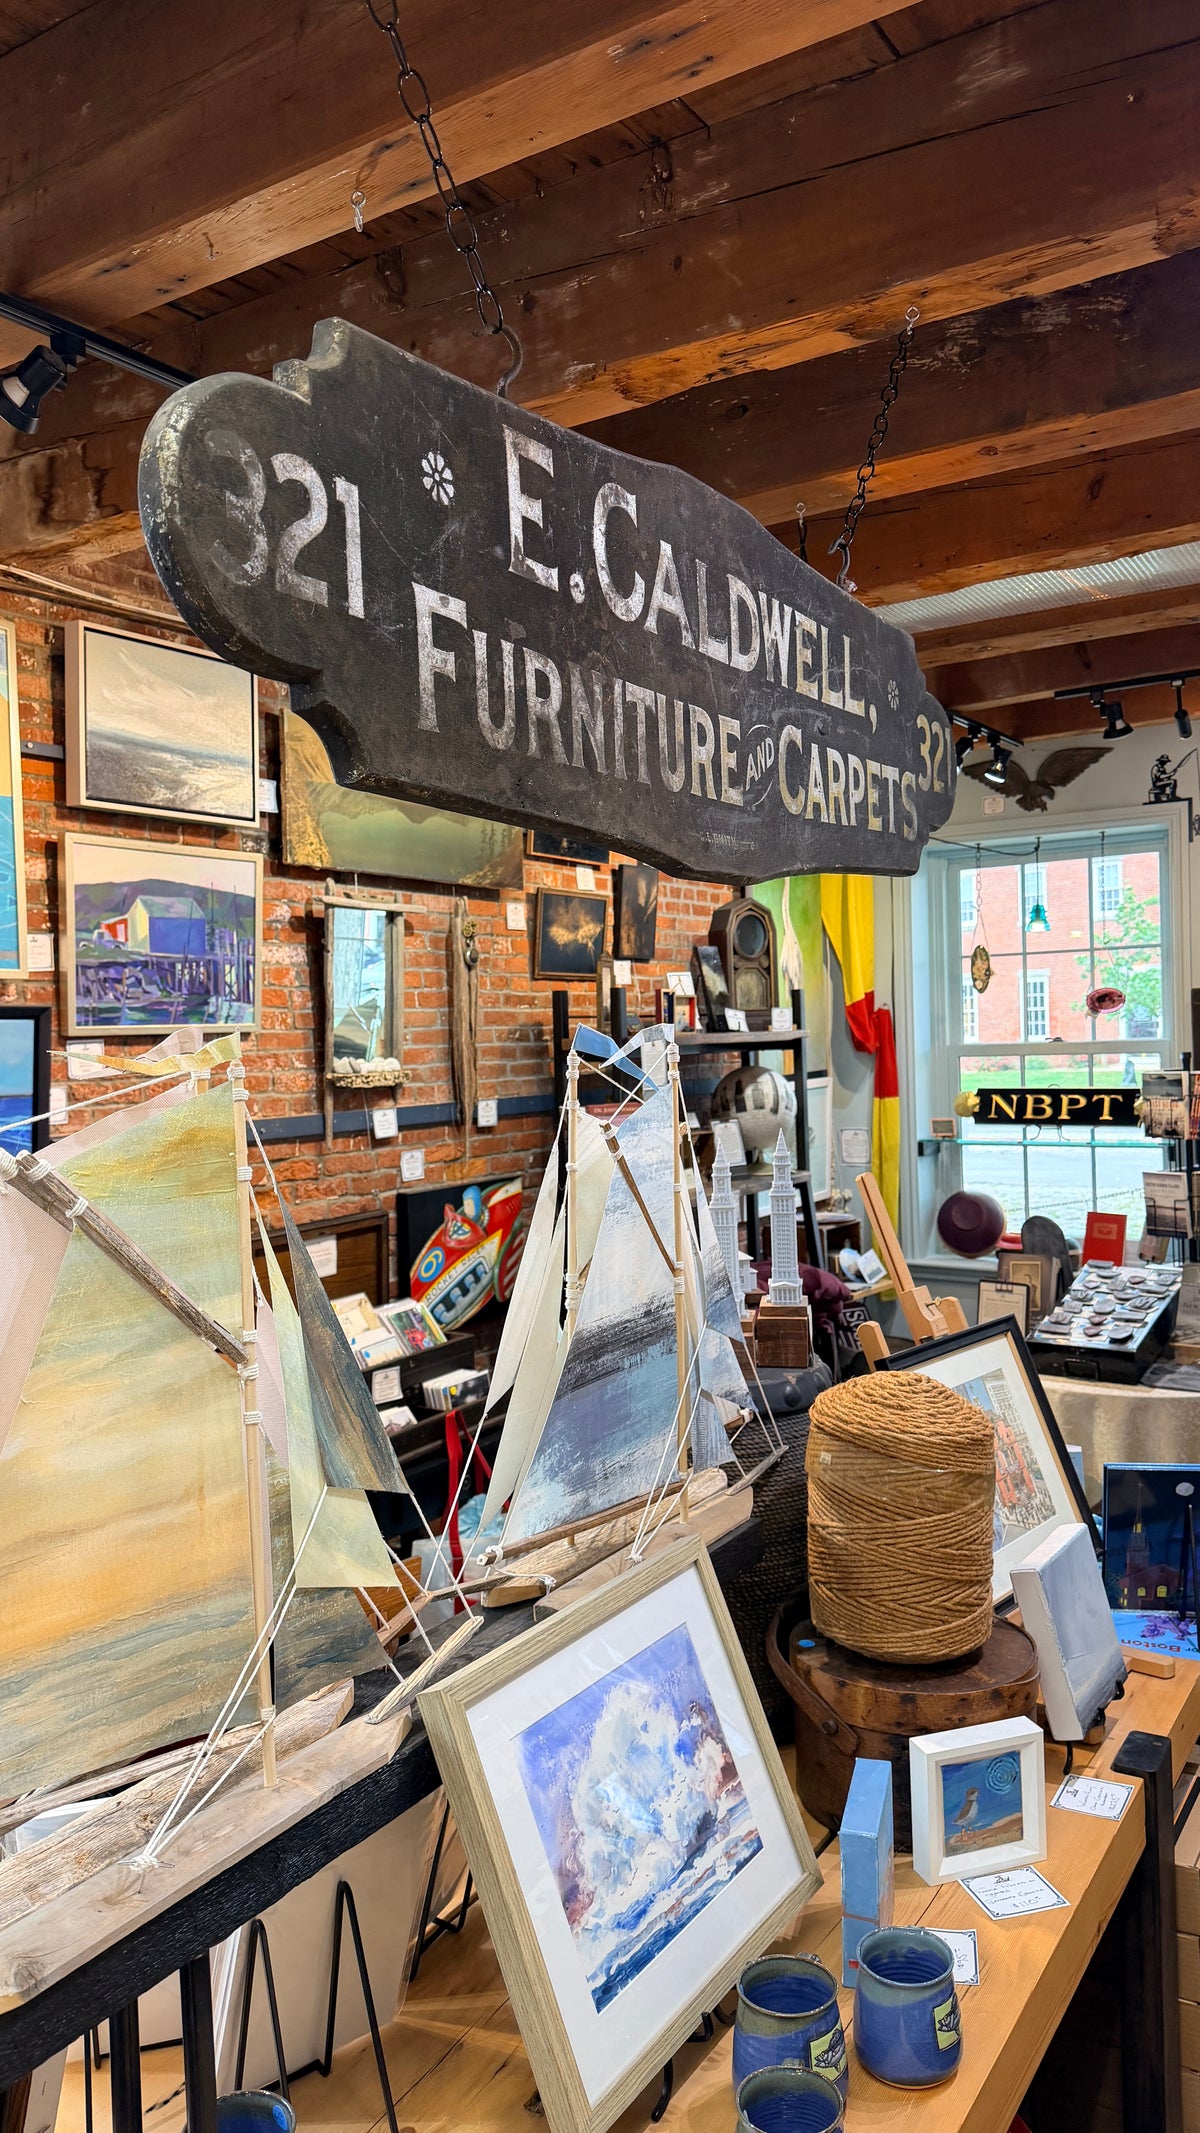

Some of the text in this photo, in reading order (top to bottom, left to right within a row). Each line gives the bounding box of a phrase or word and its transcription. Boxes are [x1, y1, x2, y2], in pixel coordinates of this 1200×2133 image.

[204, 429, 365, 619] 321
[412, 582, 917, 841] FURNITURE AND CARPETS
[917, 714, 952, 794] 321
[988, 1094, 1123, 1121] NBPT
[421, 1249, 443, 1278] 6
[425, 1244, 486, 1304] ROCKET RACER
[1121, 1639, 1181, 1653] Boston
